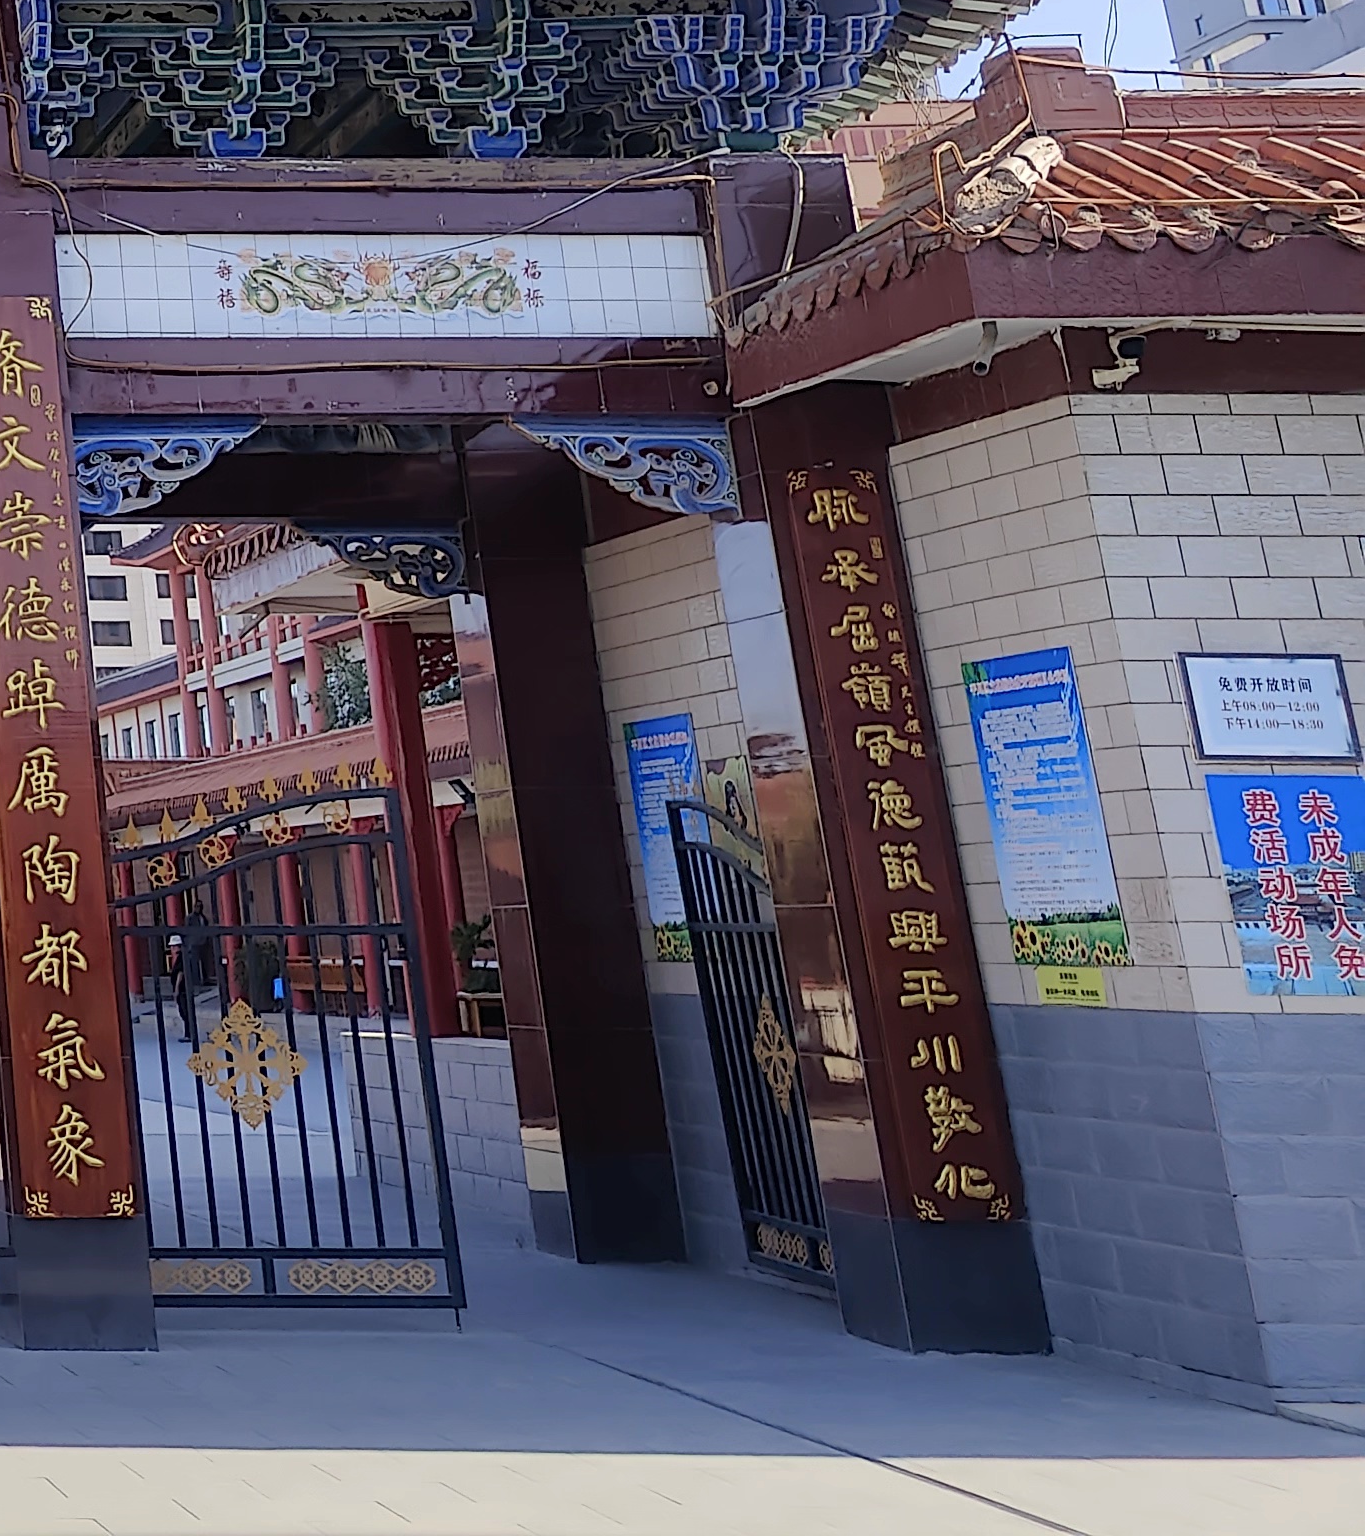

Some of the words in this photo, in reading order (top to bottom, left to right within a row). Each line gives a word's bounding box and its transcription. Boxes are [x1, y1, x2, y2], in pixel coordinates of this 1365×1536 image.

[1219, 676, 1312, 693] 免费开放时间
[1242, 788, 1313, 981] 费活动场所
[1298, 788, 1365, 981] 未成年人免
